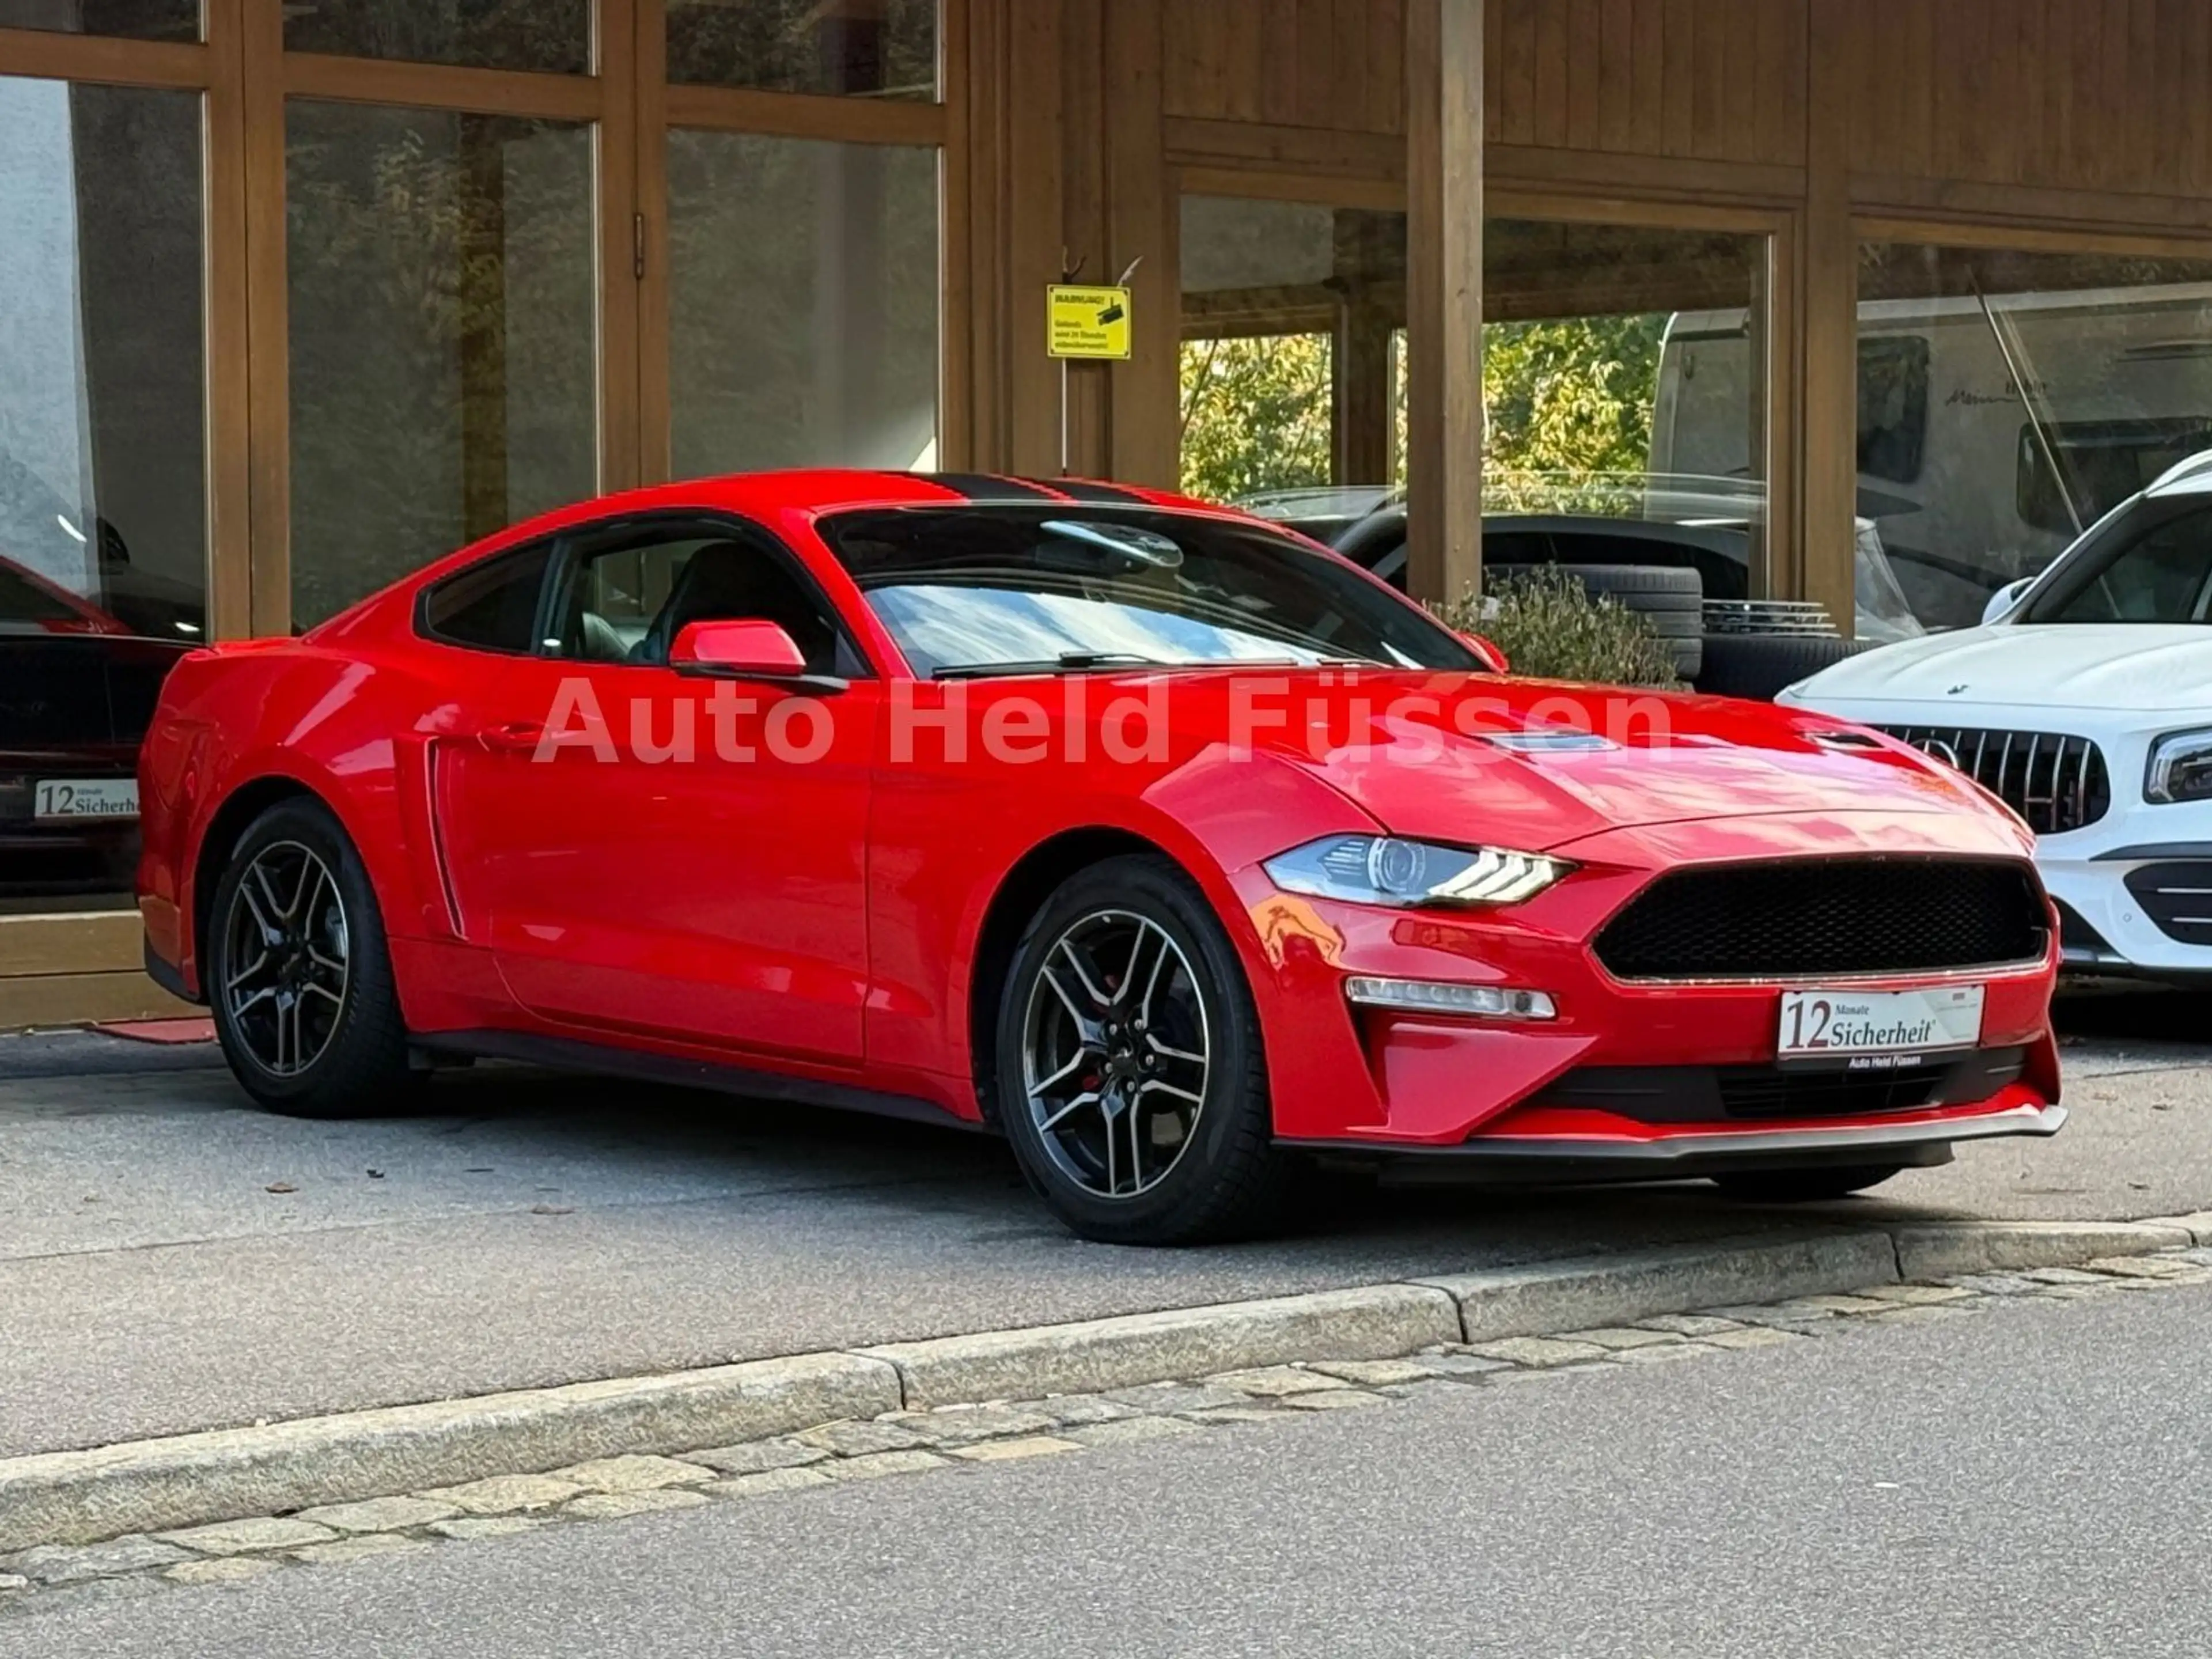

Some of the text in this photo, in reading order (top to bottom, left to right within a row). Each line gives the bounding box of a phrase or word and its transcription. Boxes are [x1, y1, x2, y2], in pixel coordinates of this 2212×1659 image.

[41, 785, 74, 815] 12
[1786, 999, 1831, 1049] 12
[1848, 1057, 1870, 1069] Auto
